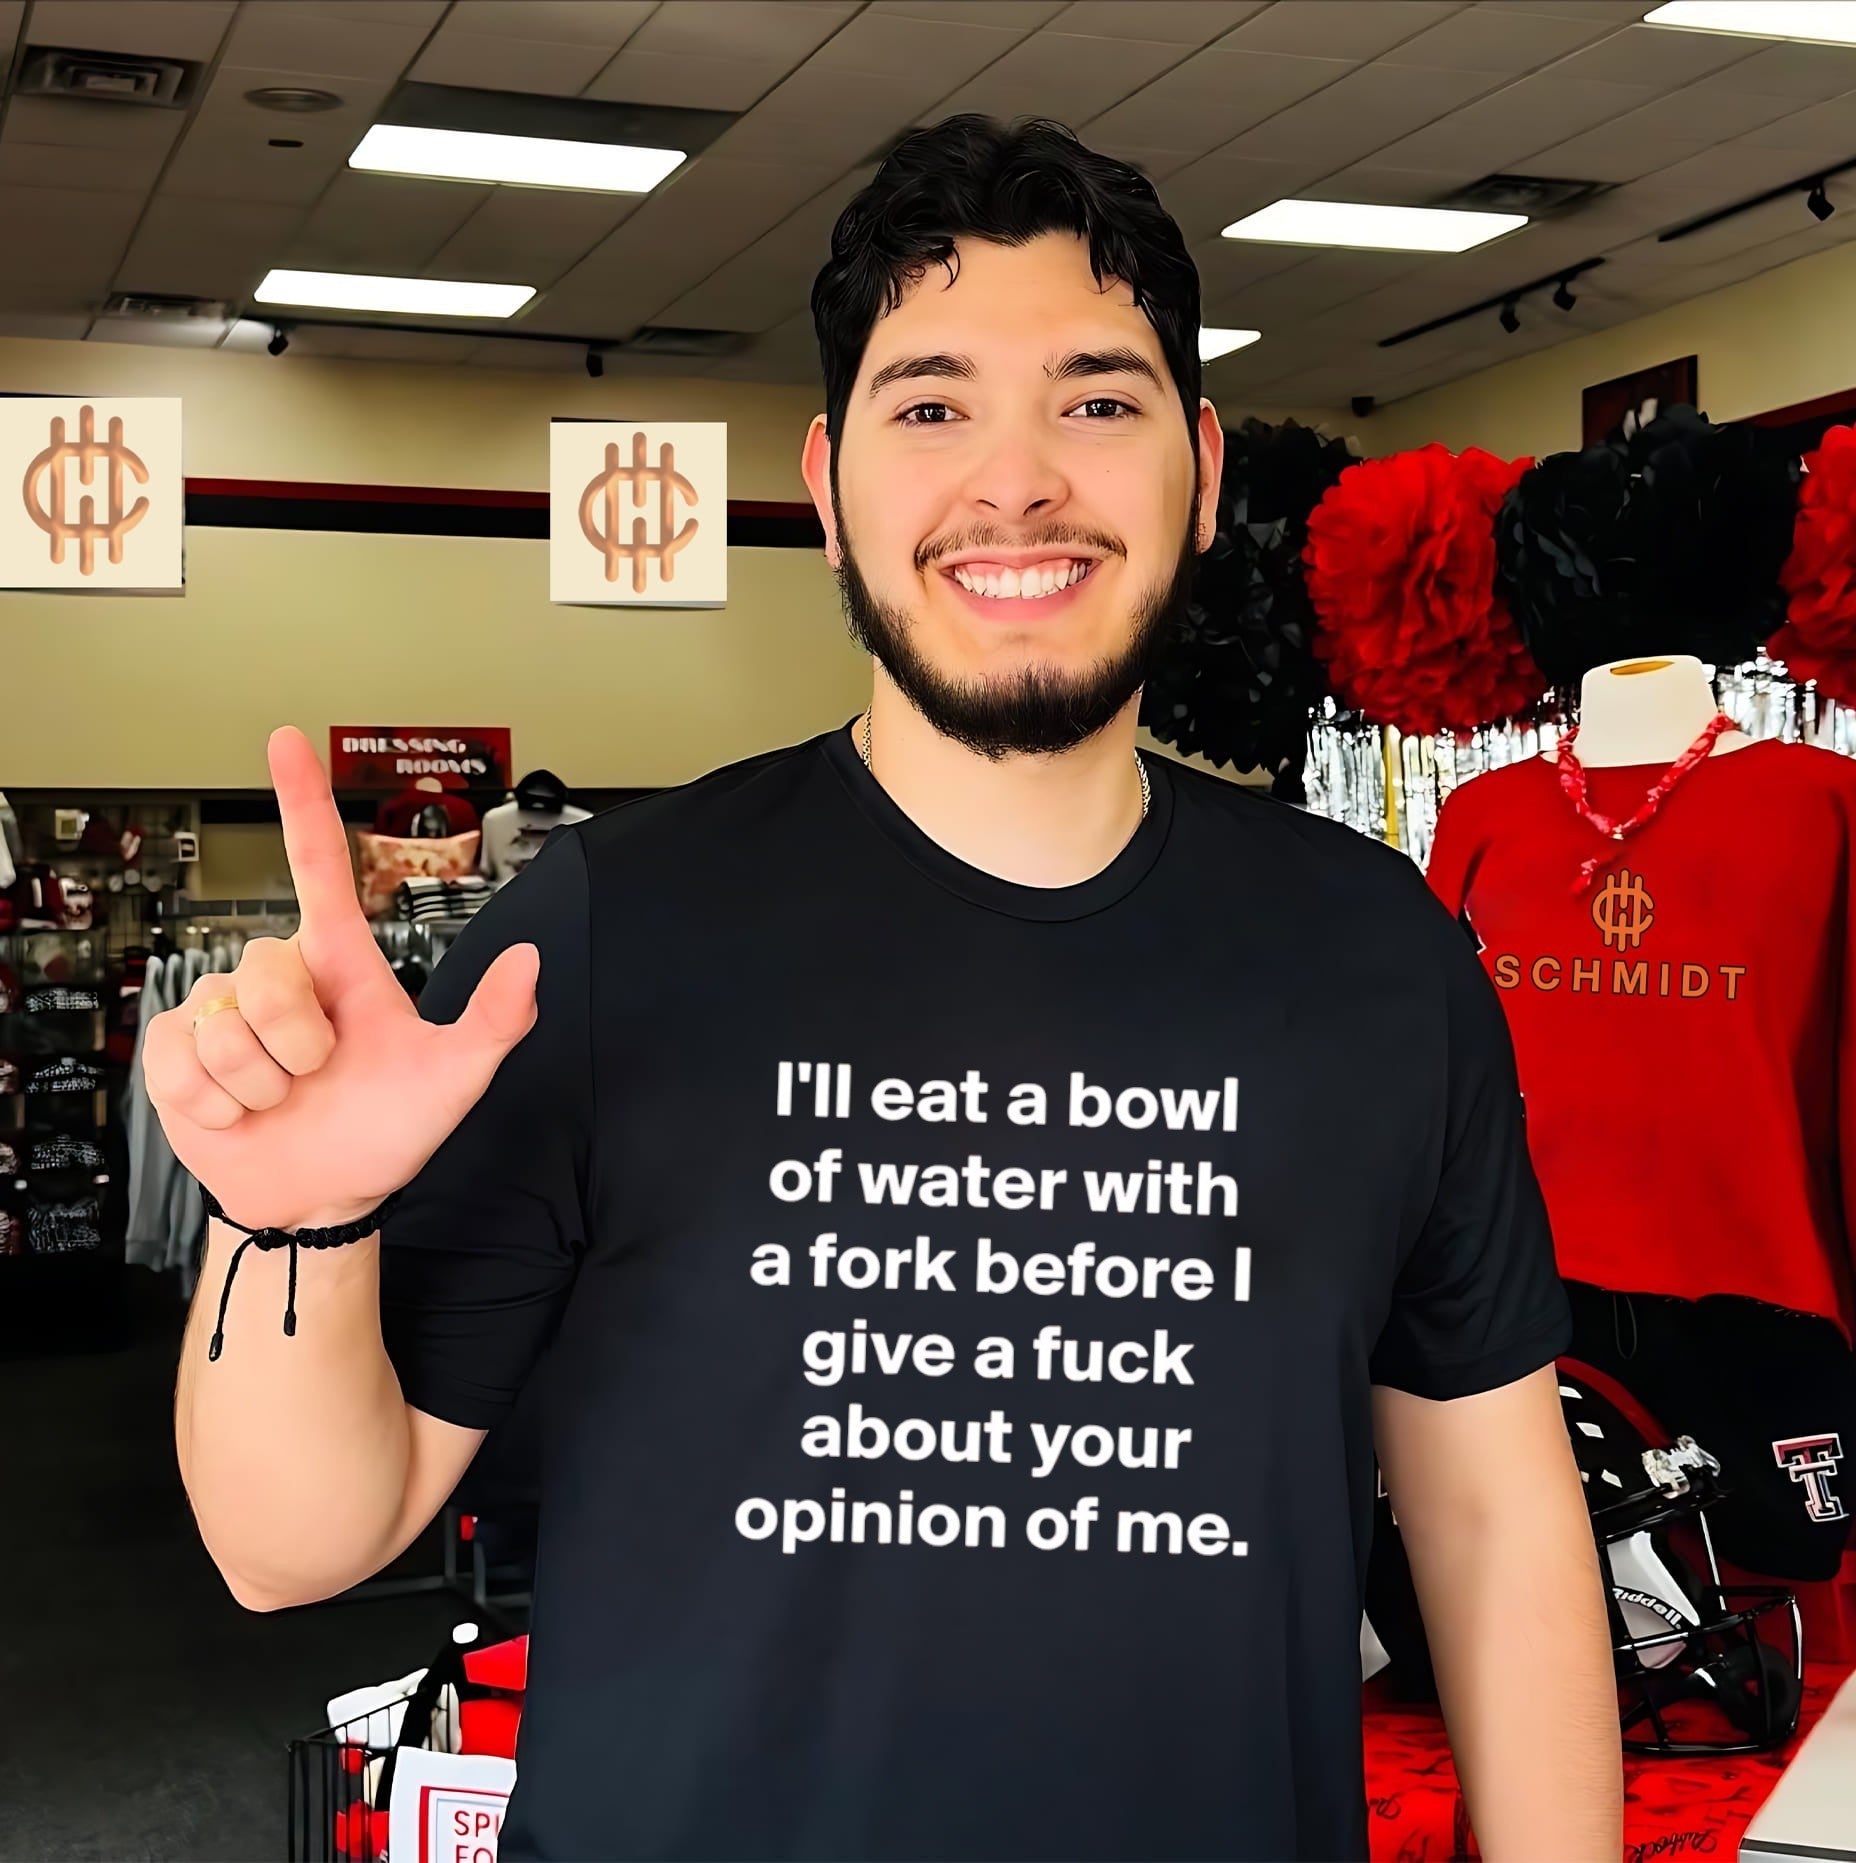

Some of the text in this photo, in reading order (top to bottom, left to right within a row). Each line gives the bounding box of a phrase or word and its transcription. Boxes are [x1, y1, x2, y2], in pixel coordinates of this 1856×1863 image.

[342, 737, 466, 754] DRESSING
[396, 759, 487, 774] ROOMS
[1495, 954, 1747, 1000] SCHMIDT
[776, 1061, 1239, 1133] I'll eat a bowl
[768, 1147, 1239, 1217] of water with
[749, 1231, 1252, 1302] a fork before I
[802, 1318, 1195, 1387] give a fuck
[800, 1402, 1193, 1479] about your
[734, 1486, 1249, 1557] opinion of me.
